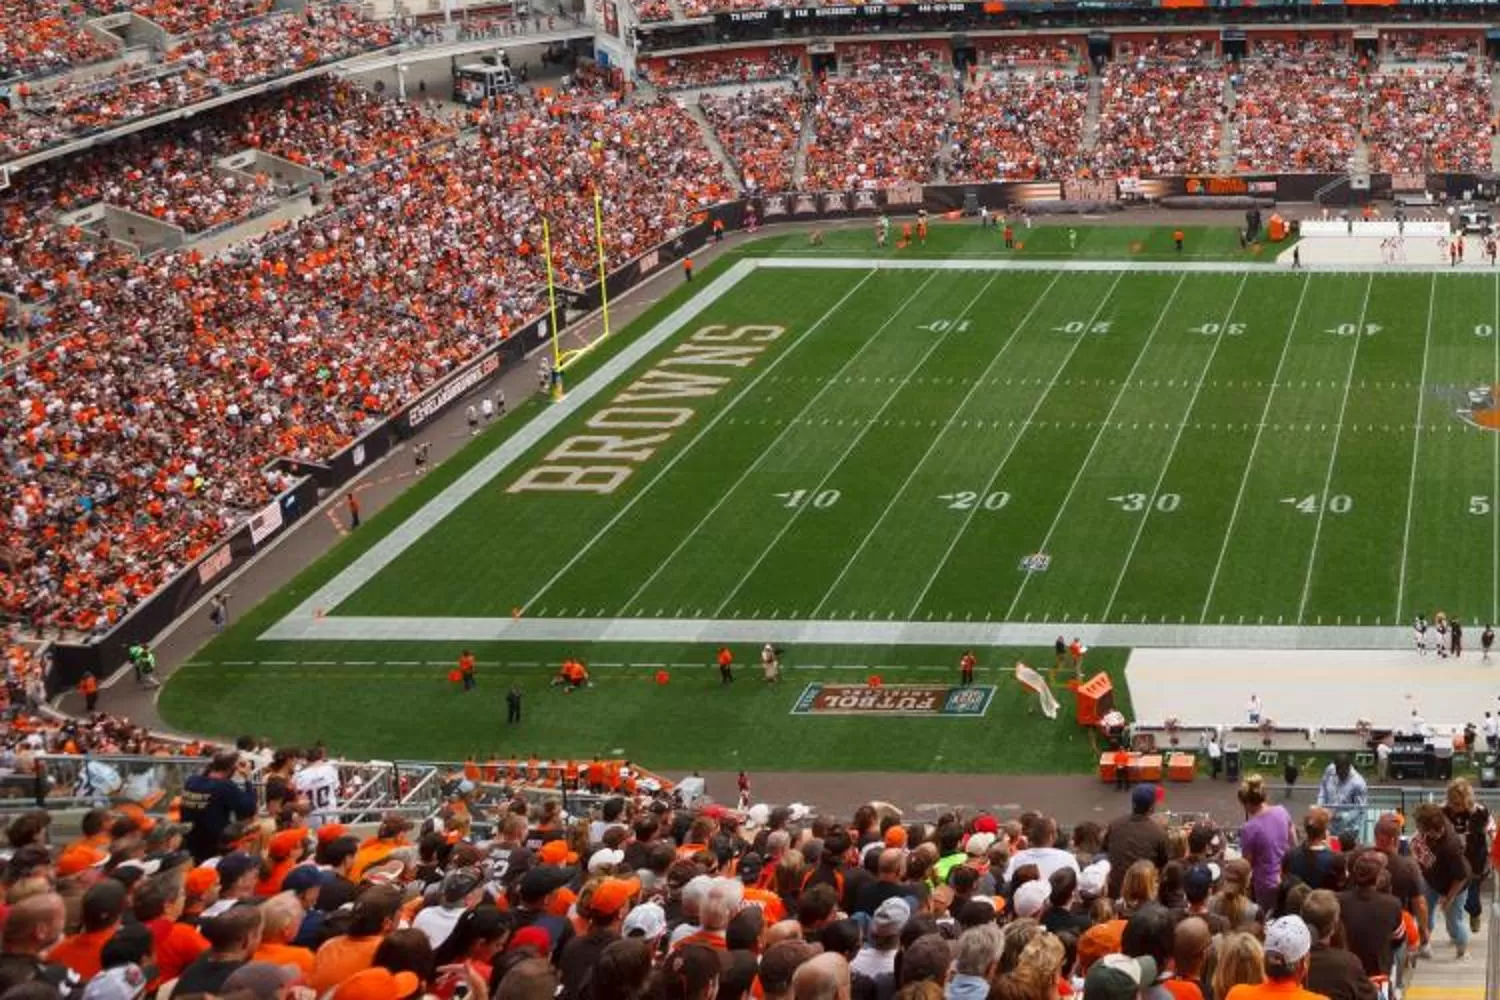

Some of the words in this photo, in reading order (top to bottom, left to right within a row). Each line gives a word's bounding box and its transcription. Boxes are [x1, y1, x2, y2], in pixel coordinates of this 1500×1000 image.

[505, 324, 787, 494] BROWNS
[781, 489, 841, 509] 10
[947, 491, 1011, 511] 20
[1120, 493, 1182, 512] 30
[1295, 494, 1353, 514] 40
[825, 695, 937, 711] FUTBOL
